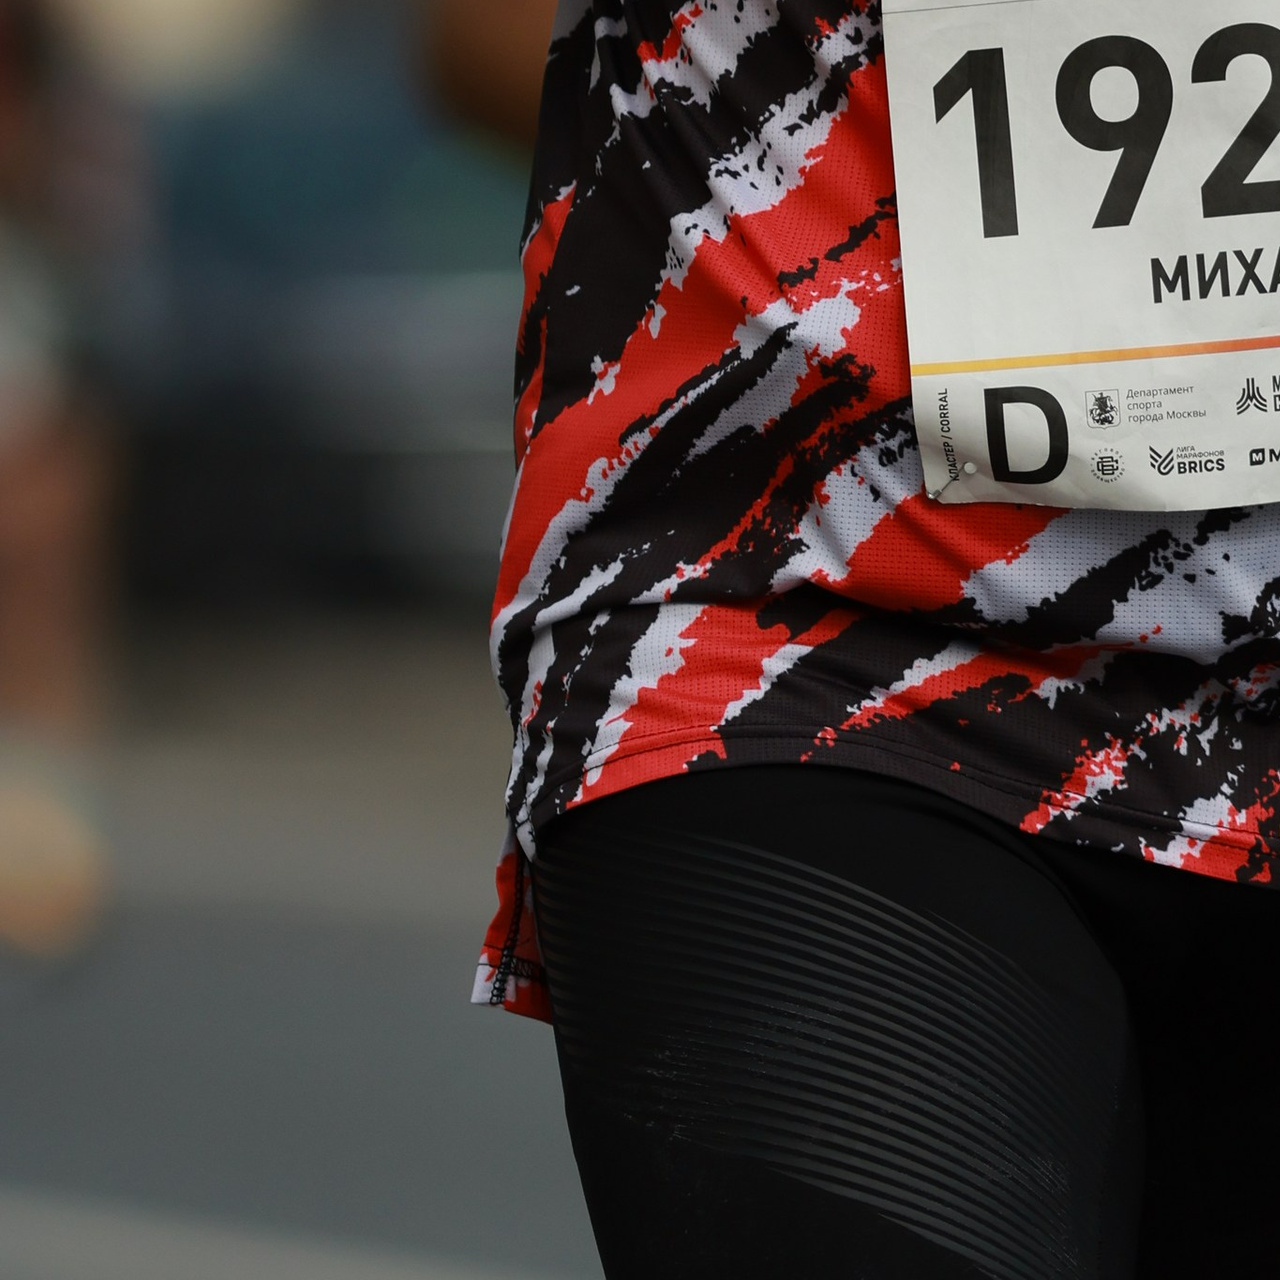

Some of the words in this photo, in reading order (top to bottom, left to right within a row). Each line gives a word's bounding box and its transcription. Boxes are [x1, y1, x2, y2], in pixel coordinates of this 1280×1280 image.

[1126, 385, 1194, 400] Департамент
[938, 388, 951, 433] CORRAL
[1127, 401, 1162, 411] спорта
[1128, 414, 1163, 424] города
[1166, 409, 1207, 420] Москвы
[984, 386, 1069, 485] D
[943, 441, 960, 481] КЛАСТЕР
[1176, 450, 1225, 459] МАРАФОНОВ
[1177, 458, 1225, 474] BRICS
